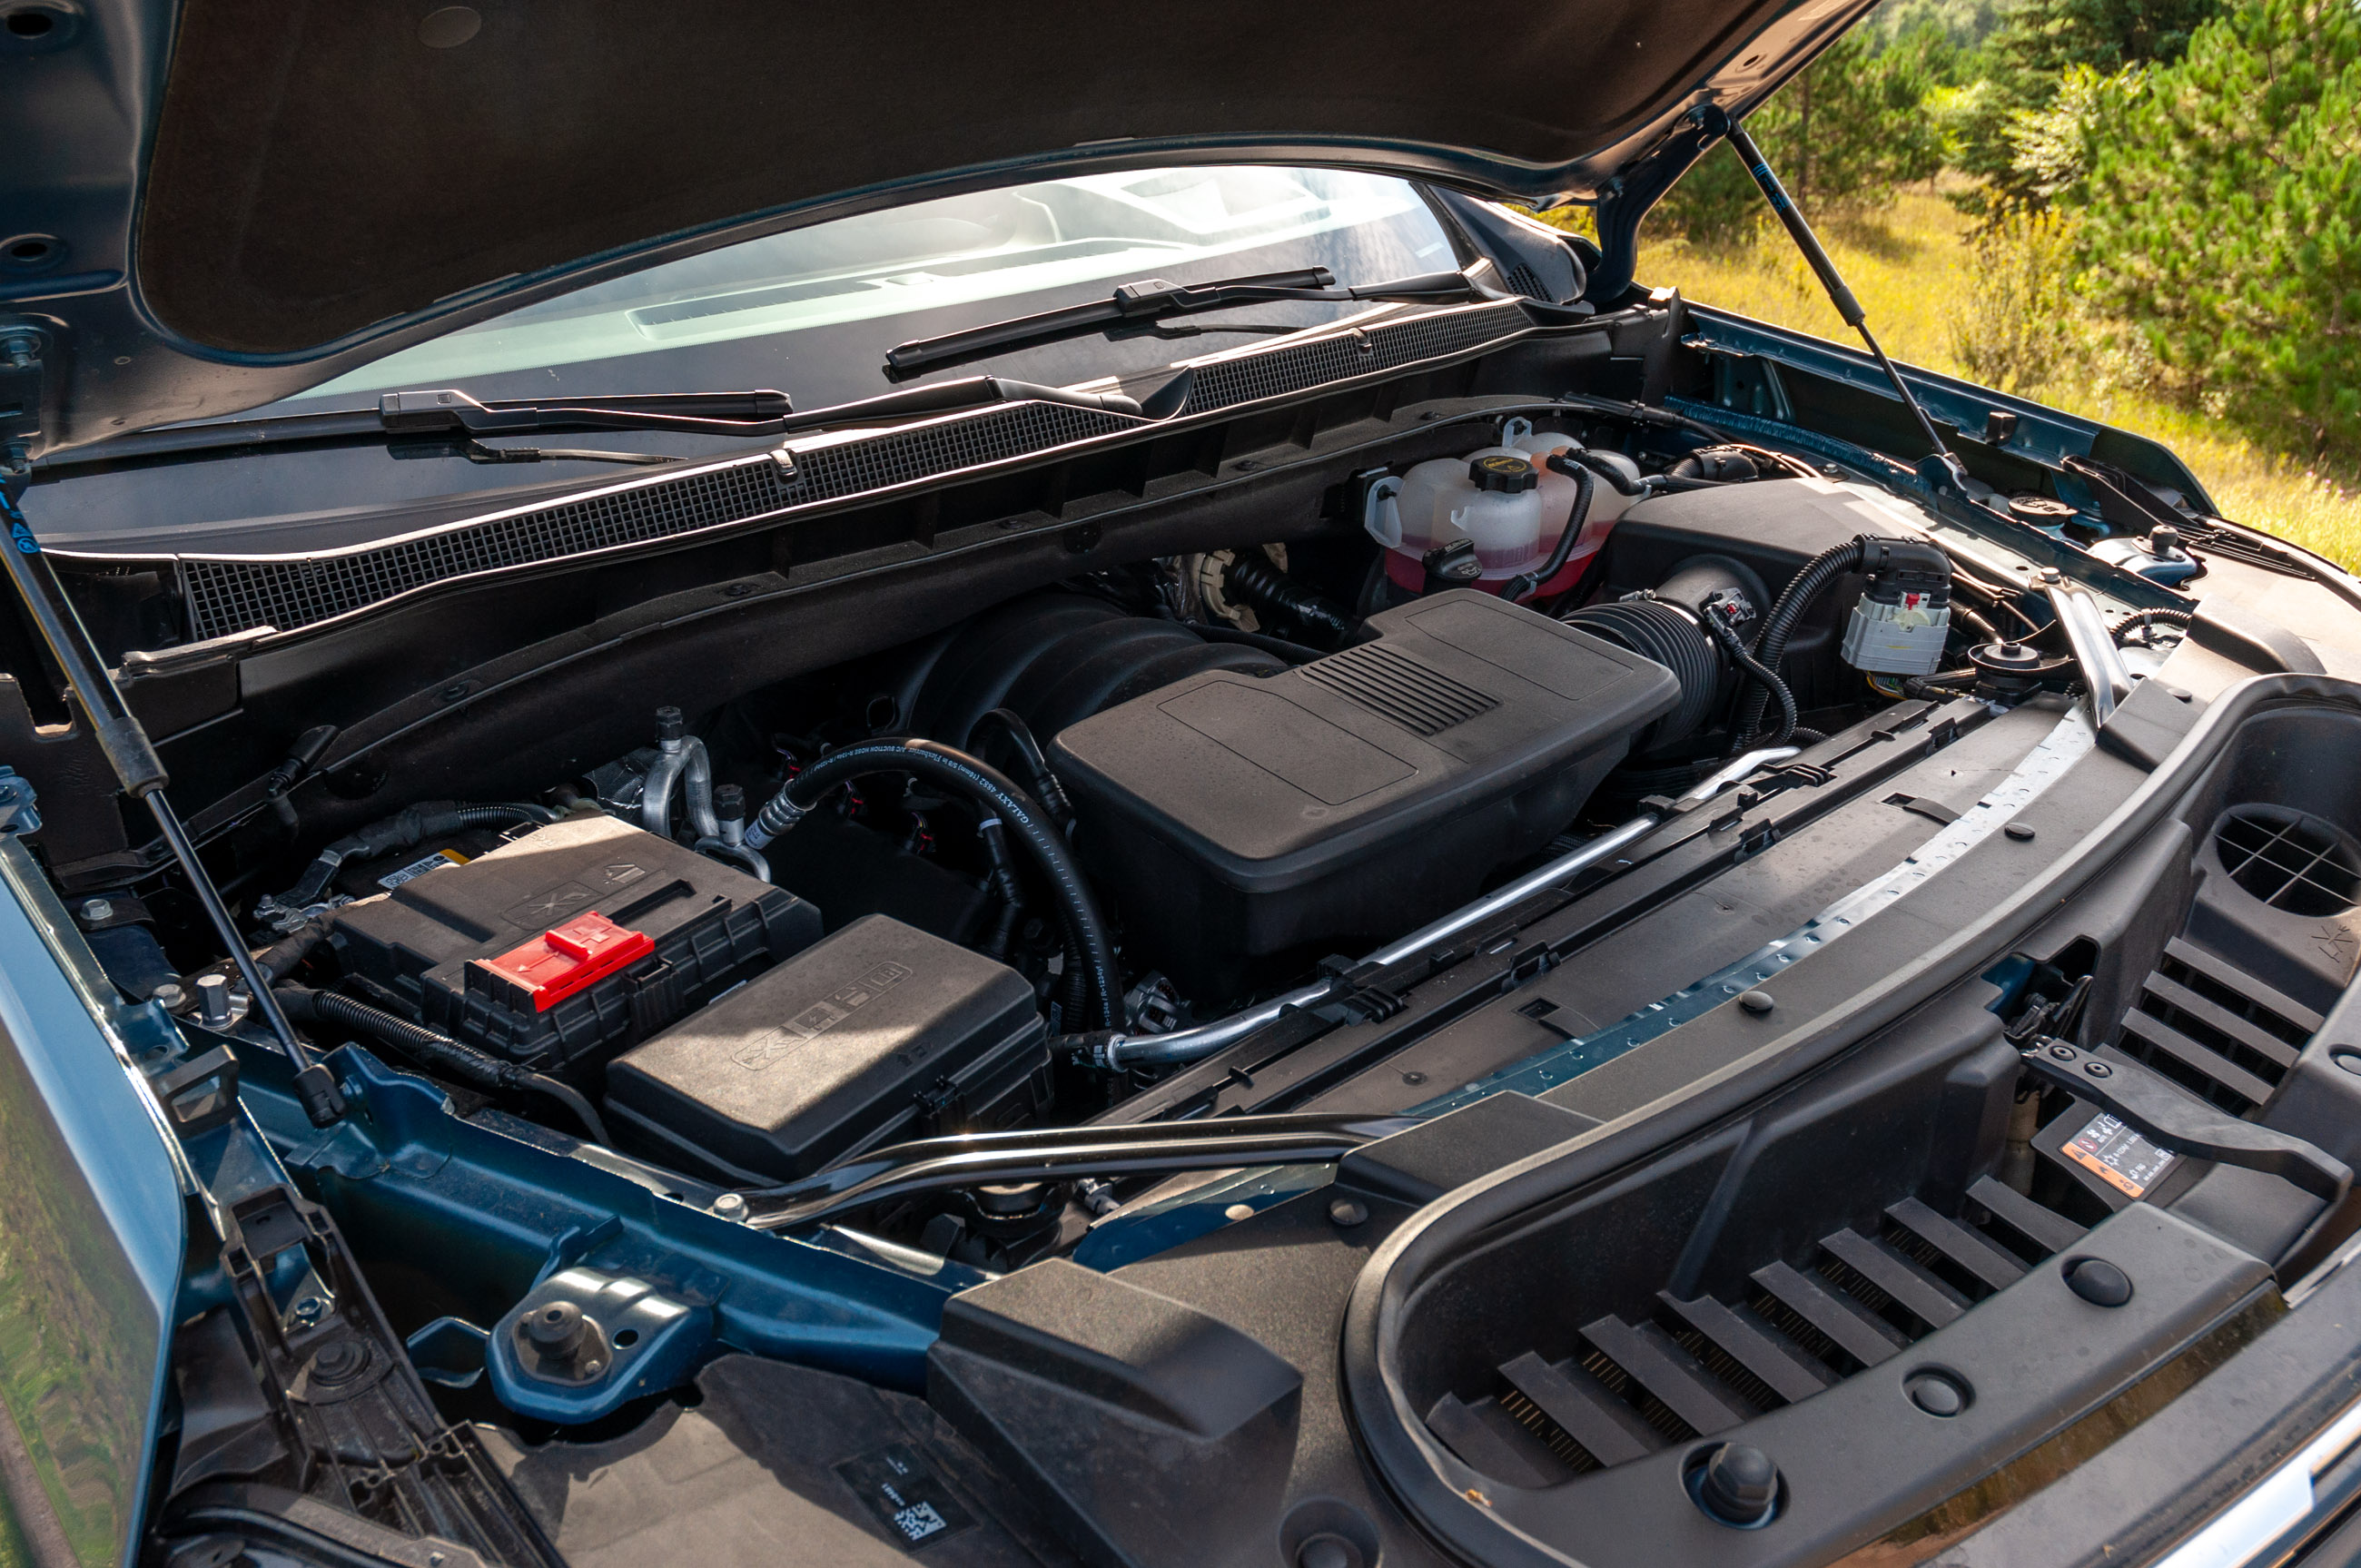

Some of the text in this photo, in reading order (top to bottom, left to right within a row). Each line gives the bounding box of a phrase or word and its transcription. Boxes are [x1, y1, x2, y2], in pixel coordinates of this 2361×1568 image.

[855, 747, 870, 755] HOSE
[948, 758, 958, 769] 5/8
[958, 764, 981, 781] (16mm)
[980, 778, 997, 793] 4882
[995, 792, 1029, 823] GALAXY
